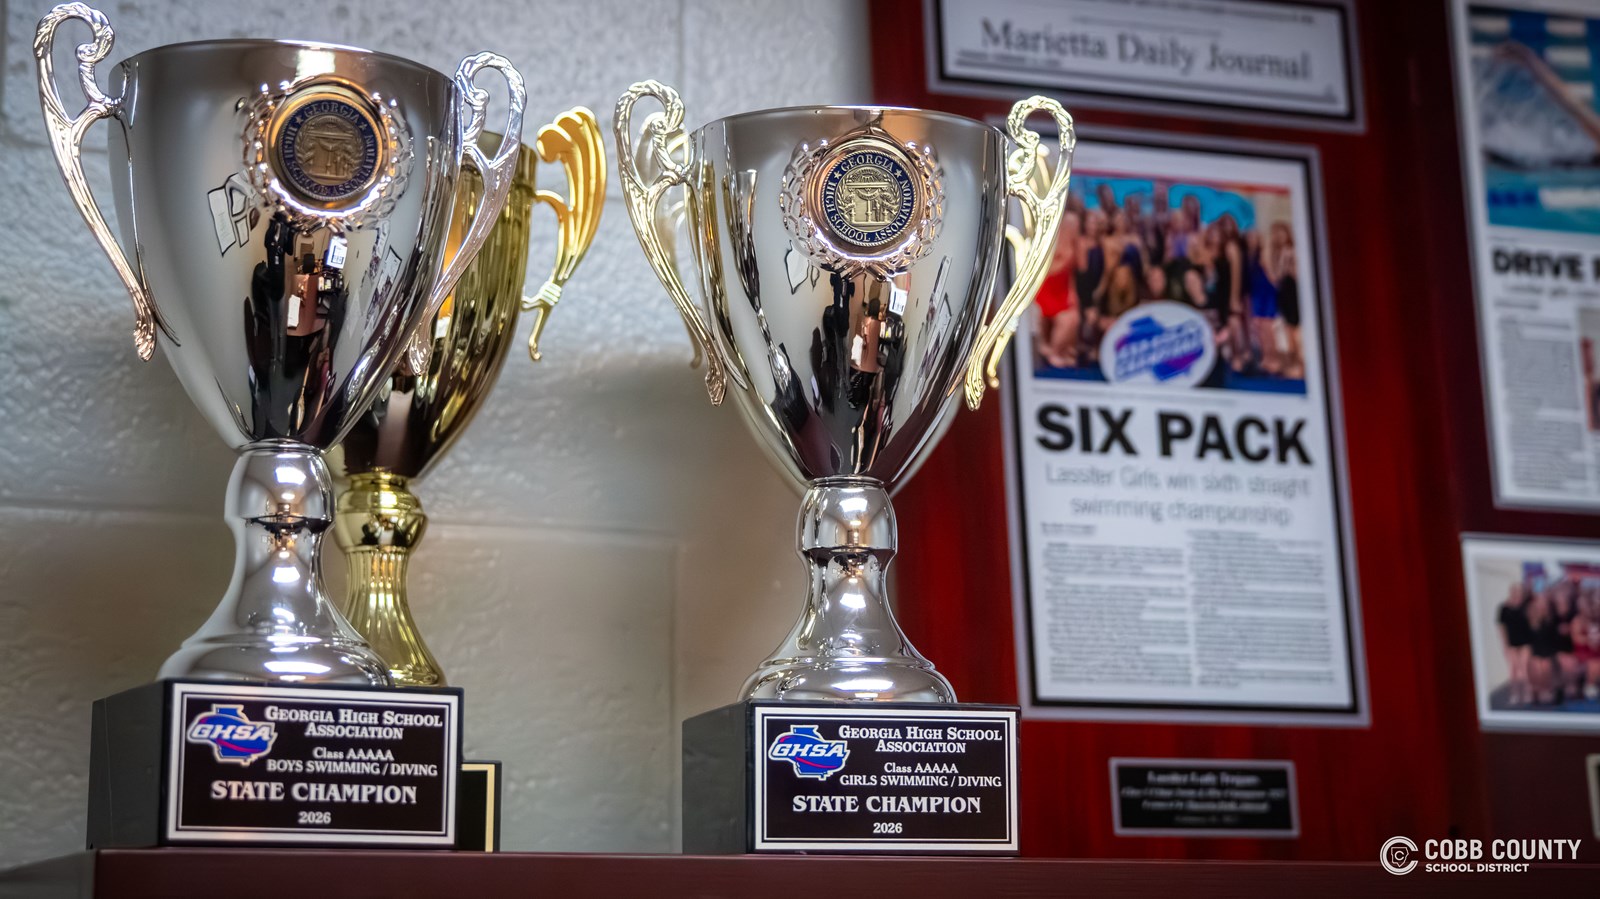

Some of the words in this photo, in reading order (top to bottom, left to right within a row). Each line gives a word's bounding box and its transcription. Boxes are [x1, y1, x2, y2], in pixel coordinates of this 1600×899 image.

[981, 17, 1108, 61] Marietta
[1117, 32, 1198, 76] Daily
[1207, 43, 1314, 82] Journal
[840, 153, 895, 172] GEORGIA
[825, 180, 837, 214] HIGH
[830, 212, 871, 242] SCHOOL
[873, 179, 913, 243] ASSOCIATION
[1492, 248, 1584, 282] DRIVE
[1035, 402, 1138, 456] SIX
[1157, 409, 1314, 466] PACK
[265, 705, 334, 723] GEORGIA
[339, 708, 379, 725] HIGH
[383, 710, 443, 727] SCHOOL
[190, 723, 272, 742] GHSA
[305, 722, 404, 739] ASSOCIATION
[838, 725, 902, 740] GEORGIA
[906, 726, 943, 741] HIGH
[946, 727, 1003, 742] SCHOOL
[313, 747, 344, 760] Class
[346, 749, 395, 761] AAAAA
[771, 742, 846, 758] GHSA
[876, 739, 966, 754] ASSOCIATION
[267, 759, 303, 773] BOYS
[306, 761, 380, 775] SWIMMING
[390, 764, 438, 777] DIVING
[884, 762, 912, 774] Class
[914, 763, 959, 774] AAAAA
[839, 775, 878, 787] GIRLS
[880, 775, 949, 787] SWIMMING
[958, 776, 1002, 788] DIVING
[211, 780, 285, 800] STATE
[292, 782, 417, 804] CHAMPION
[793, 795, 859, 812] STATE
[865, 796, 982, 814] CHAMPION
[298, 811, 331, 824] 2026
[873, 822, 903, 834] 2026
